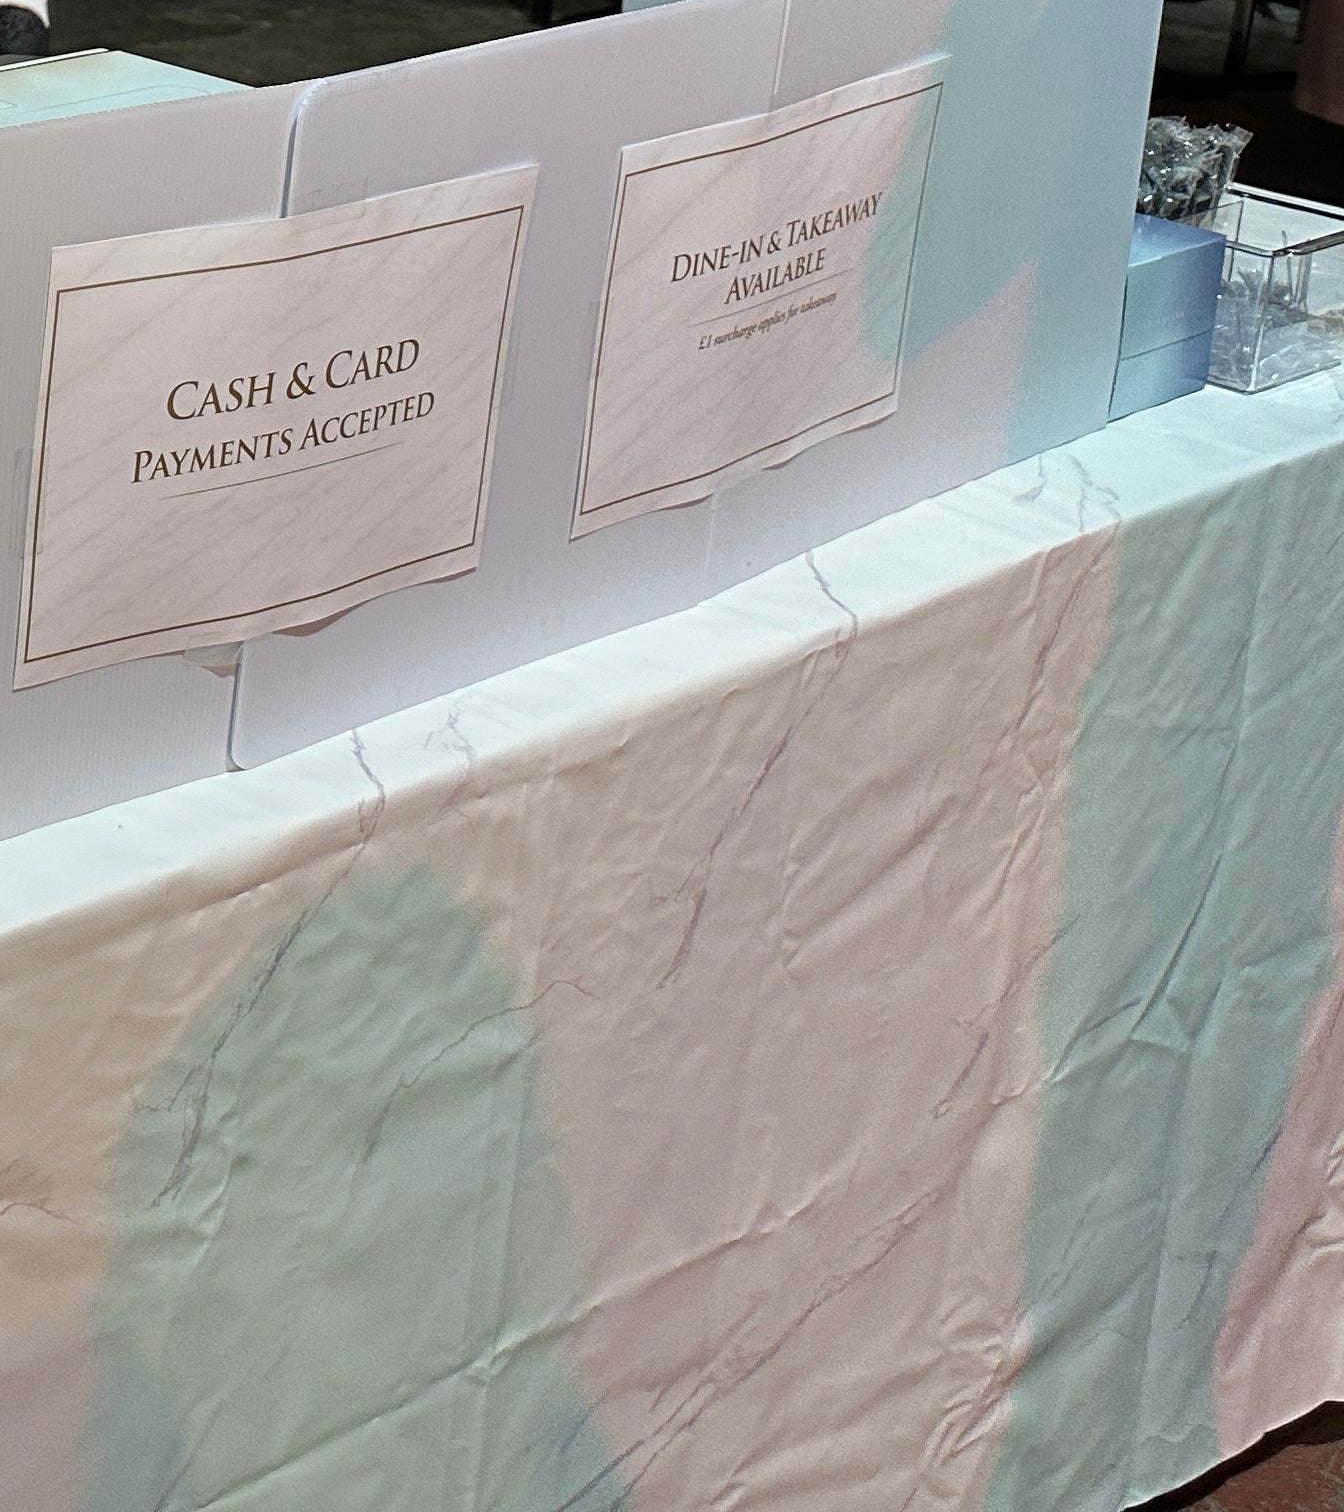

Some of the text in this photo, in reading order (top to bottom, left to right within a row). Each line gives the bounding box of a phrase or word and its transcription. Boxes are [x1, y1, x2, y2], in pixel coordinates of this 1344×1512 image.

[671, 191, 882, 283] DINE-IN & TAKEAWAY
[723, 247, 826, 304] AVAILABLE
[166, 338, 419, 420] CASH & CARD
[131, 391, 435, 484] PAYMENTS ACCEPTED
